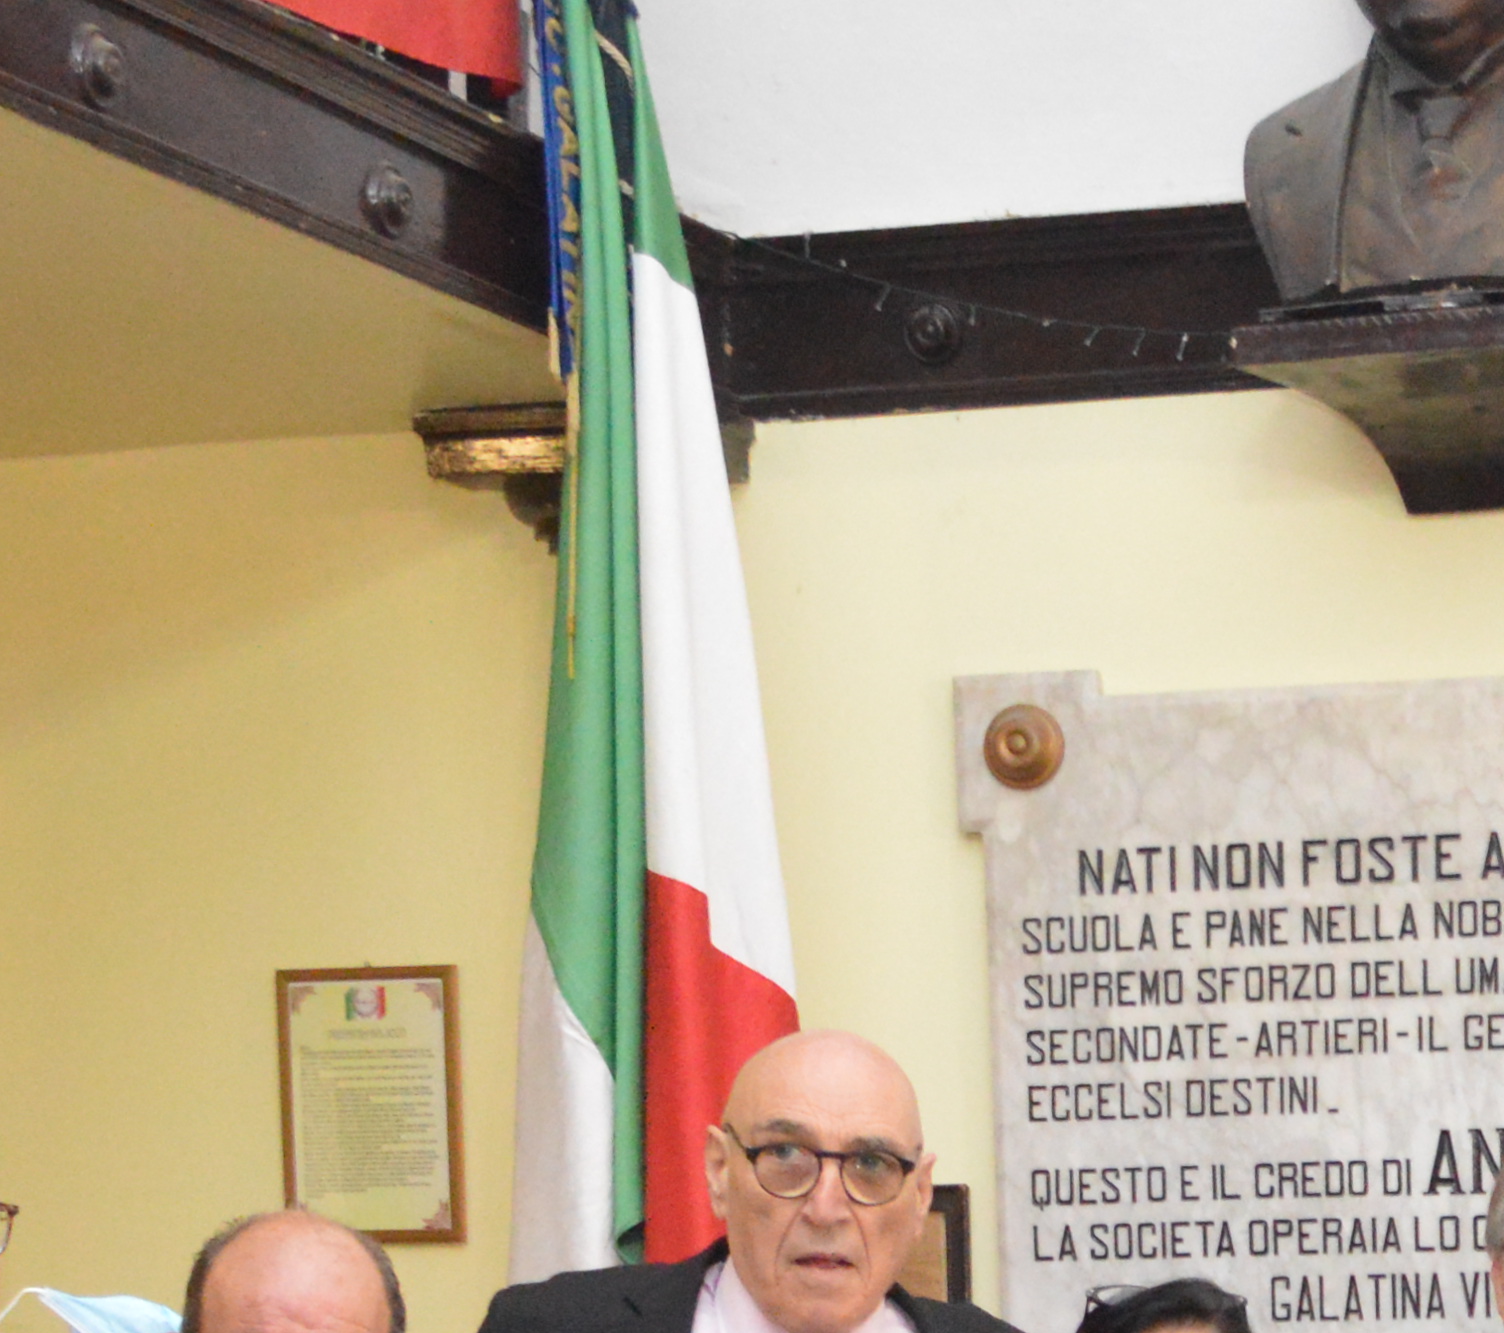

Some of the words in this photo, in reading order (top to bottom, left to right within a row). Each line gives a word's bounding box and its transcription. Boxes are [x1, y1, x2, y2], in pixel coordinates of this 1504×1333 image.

[1078, 847, 1178, 897] NATI
[1192, 841, 1286, 893] NON
[1302, 834, 1461, 888] FOSTE
[1022, 913, 1158, 956] SCUOLA
[1171, 912, 1192, 951] E
[1204, 907, 1289, 949] PANE
[1302, 903, 1419, 945] NELLA
[1024, 968, 1185, 1009] SUPREMO
[1197, 962, 1336, 1004] SFORZO
[1351, 959, 1443, 1000] DELL
[1027, 1081, 1172, 1122] ECCELSI
[1031, 1166, 1167, 1211] QUESTO
[1181, 1164, 1198, 1202] E
[1211, 1163, 1241, 1201] IL
[1255, 1160, 1369, 1200] CREDO
[1382, 1158, 1412, 1197] DI
[1032, 1223, 1078, 1262] LA
[1090, 1219, 1236, 1262] SOCIETA
[1248, 1215, 1402, 1259] OPERAIA
[1414, 1214, 1460, 1252] LO
[1270, 1272, 1446, 1323] GALATINA
